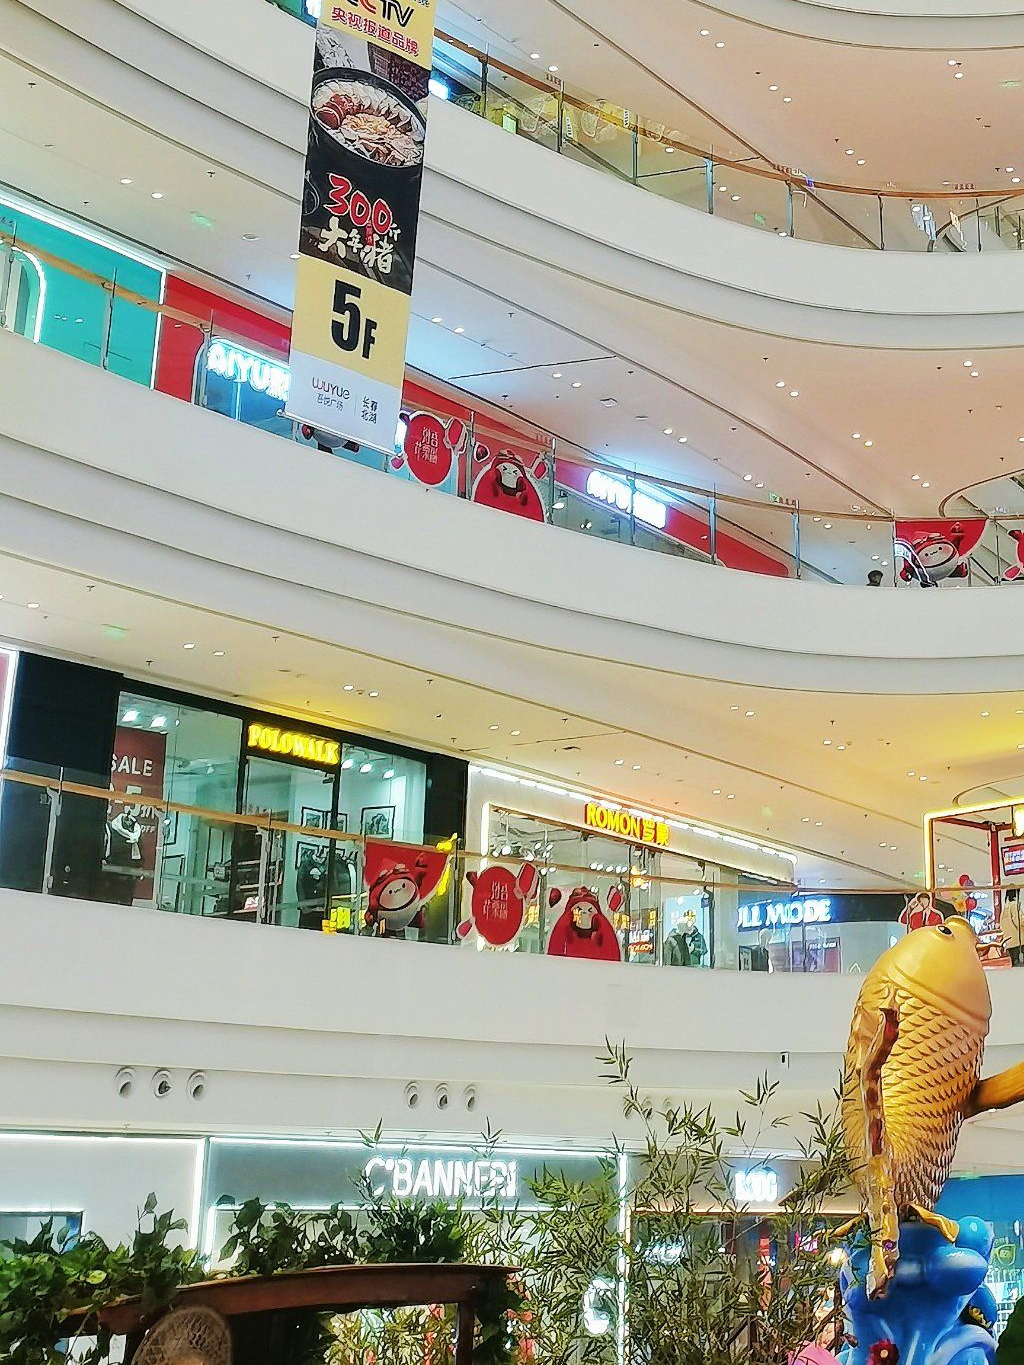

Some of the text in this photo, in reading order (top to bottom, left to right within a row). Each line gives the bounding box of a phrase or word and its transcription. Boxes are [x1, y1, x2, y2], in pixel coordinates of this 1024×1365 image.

[331, 6, 419, 57] 央视报道品牌
[331, 279, 378, 359] 5F
[585, 802, 641, 840] ROMON
[765, 898, 832, 927] MODE
